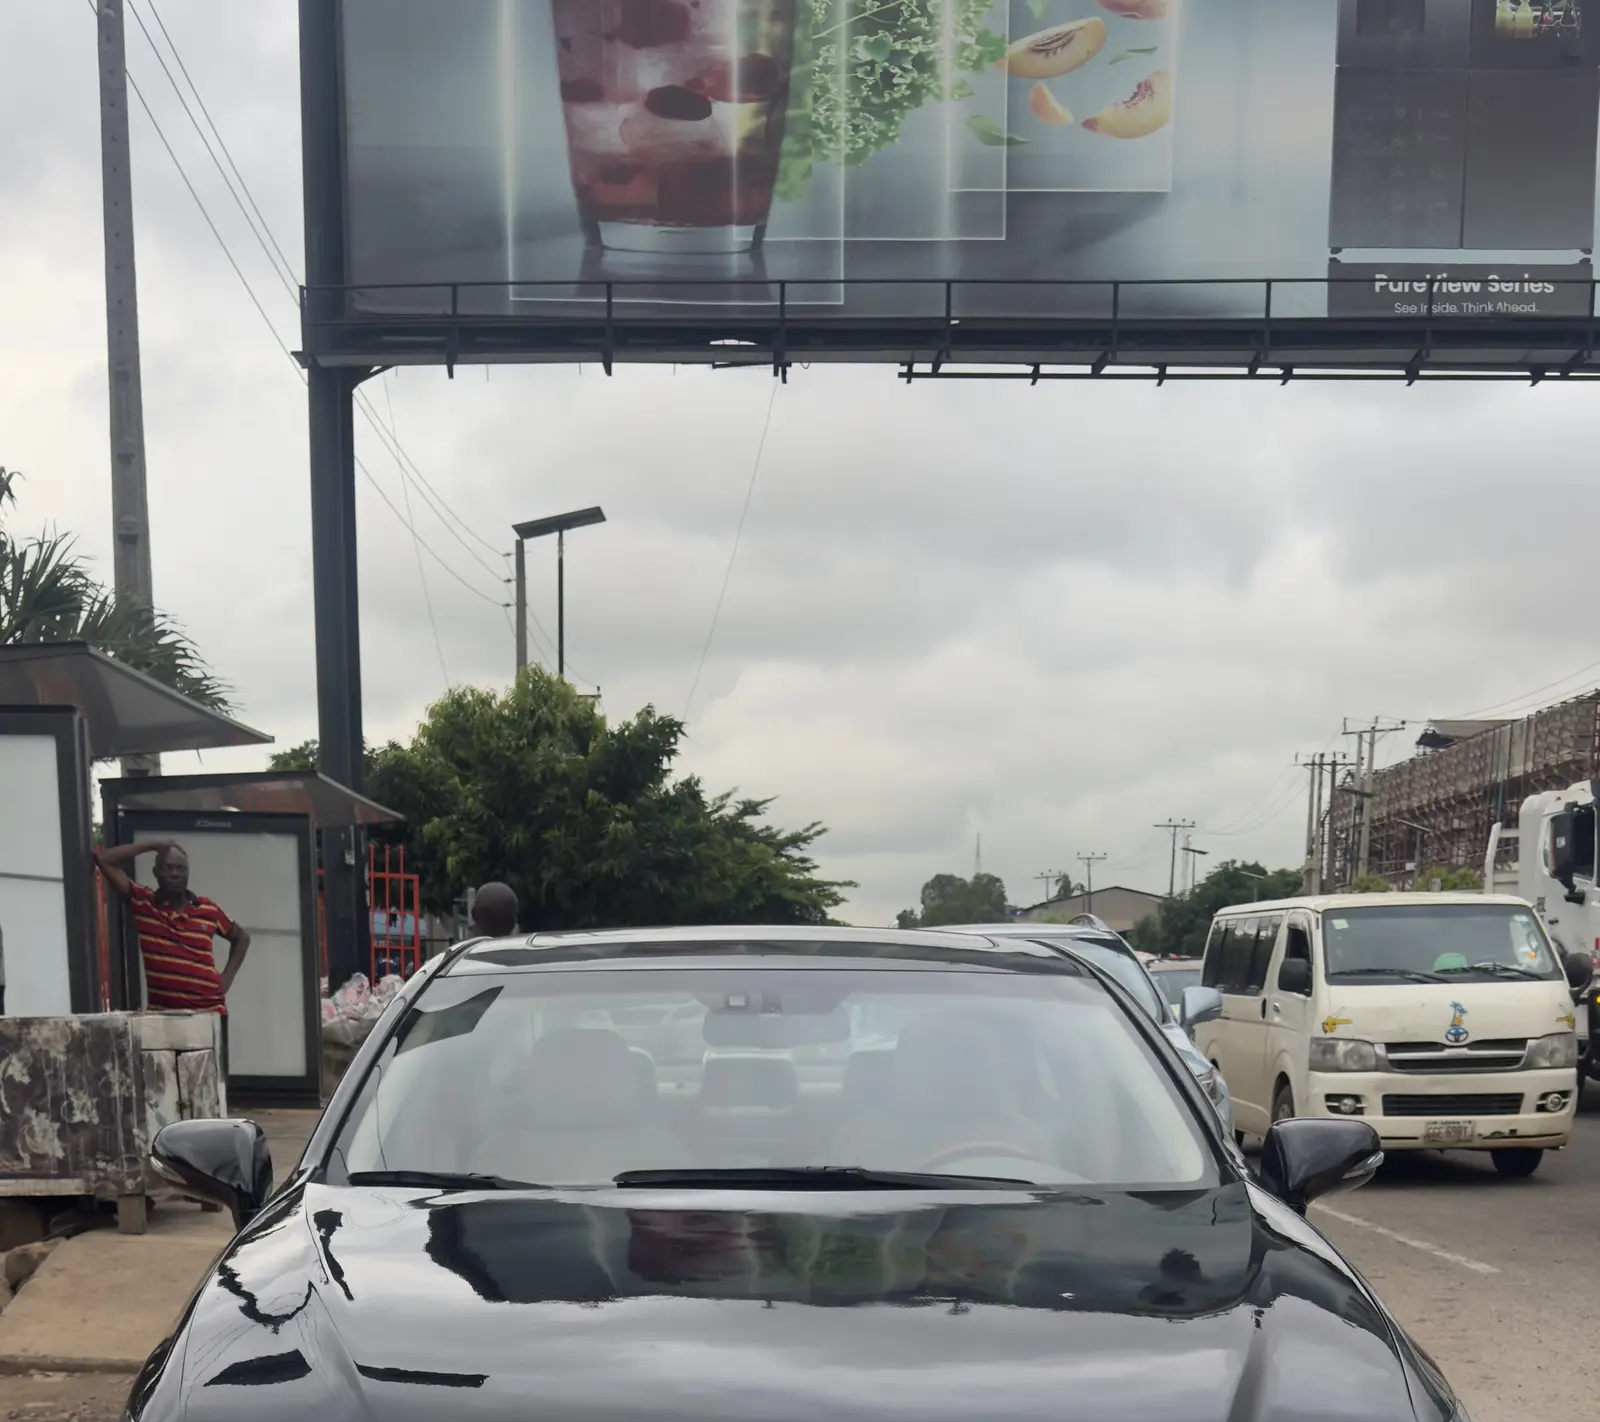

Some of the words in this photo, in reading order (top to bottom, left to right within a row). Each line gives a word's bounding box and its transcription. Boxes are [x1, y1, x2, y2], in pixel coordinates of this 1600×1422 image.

[1487, 273, 1555, 293] Series
[1394, 302, 1418, 313] See
[1461, 301, 1494, 313] Think
[1496, 301, 1539, 312] Ahead.
